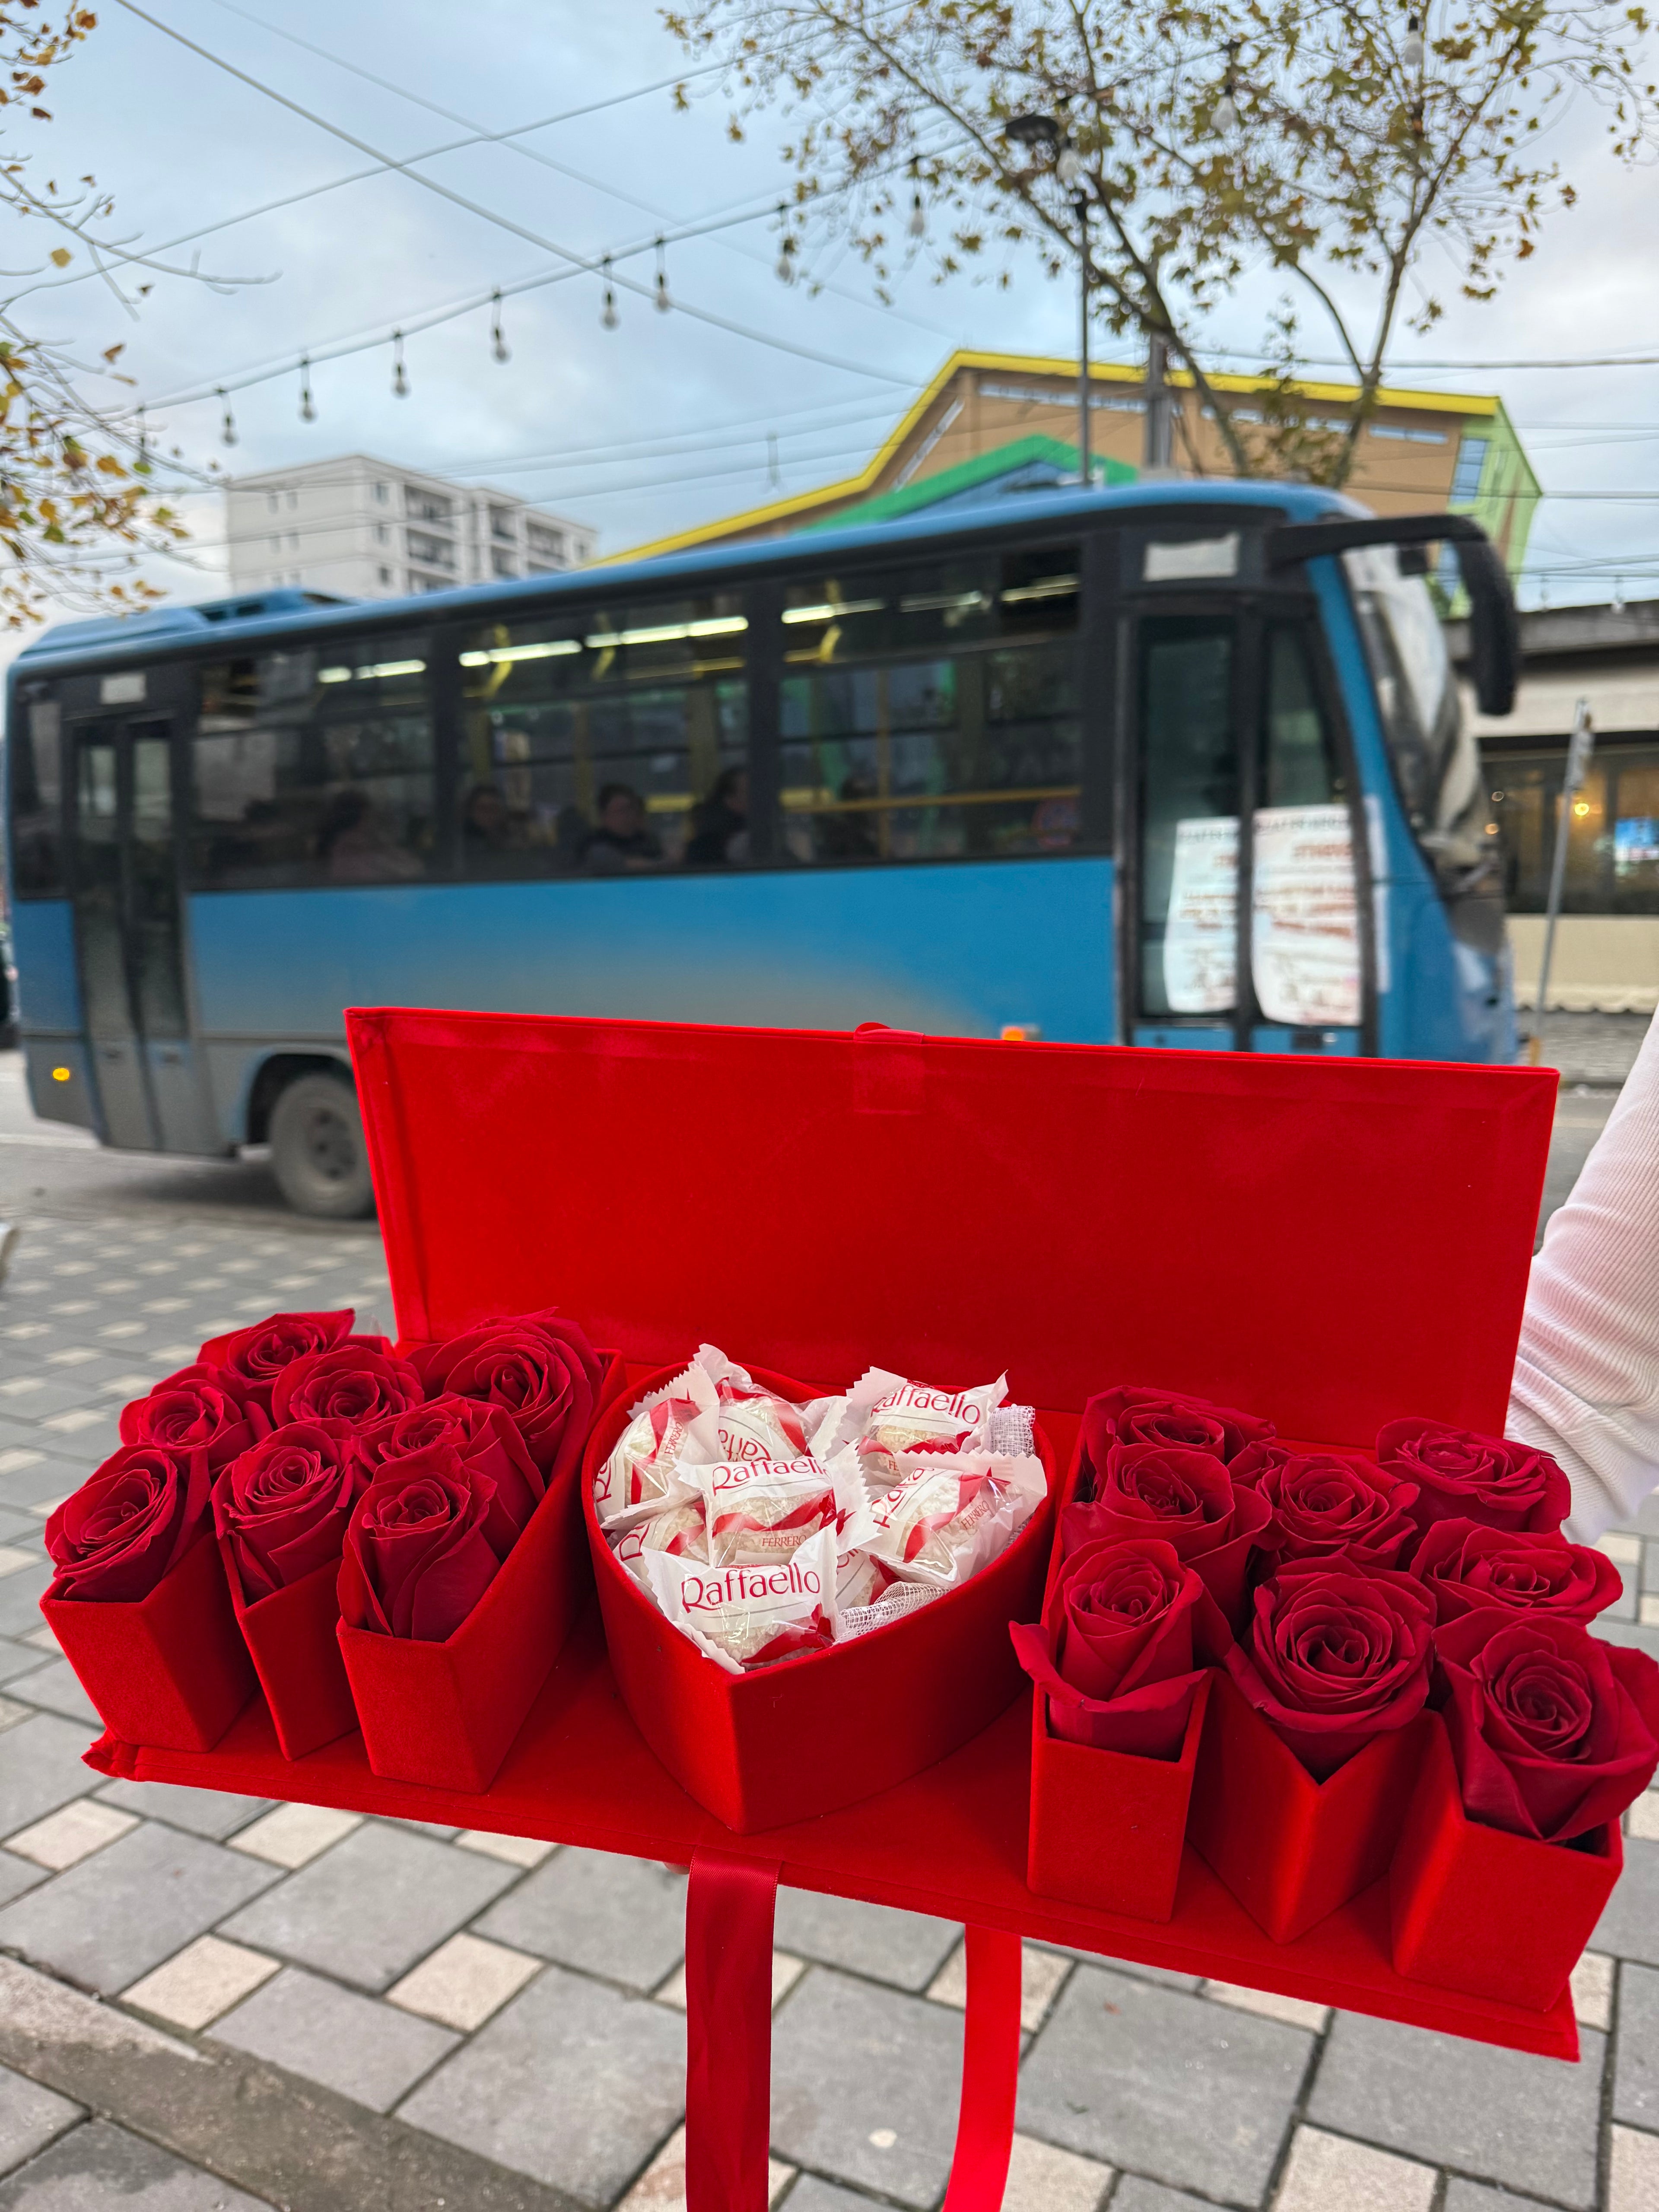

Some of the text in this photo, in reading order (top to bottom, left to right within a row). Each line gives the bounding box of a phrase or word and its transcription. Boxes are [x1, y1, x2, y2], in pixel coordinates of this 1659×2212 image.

[664, 1421, 683, 1455] FERRERO
[960, 1500, 990, 1530] FERRERO
[762, 1535, 807, 1547] FERRERO
[681, 1562, 820, 1614] Raffaello
